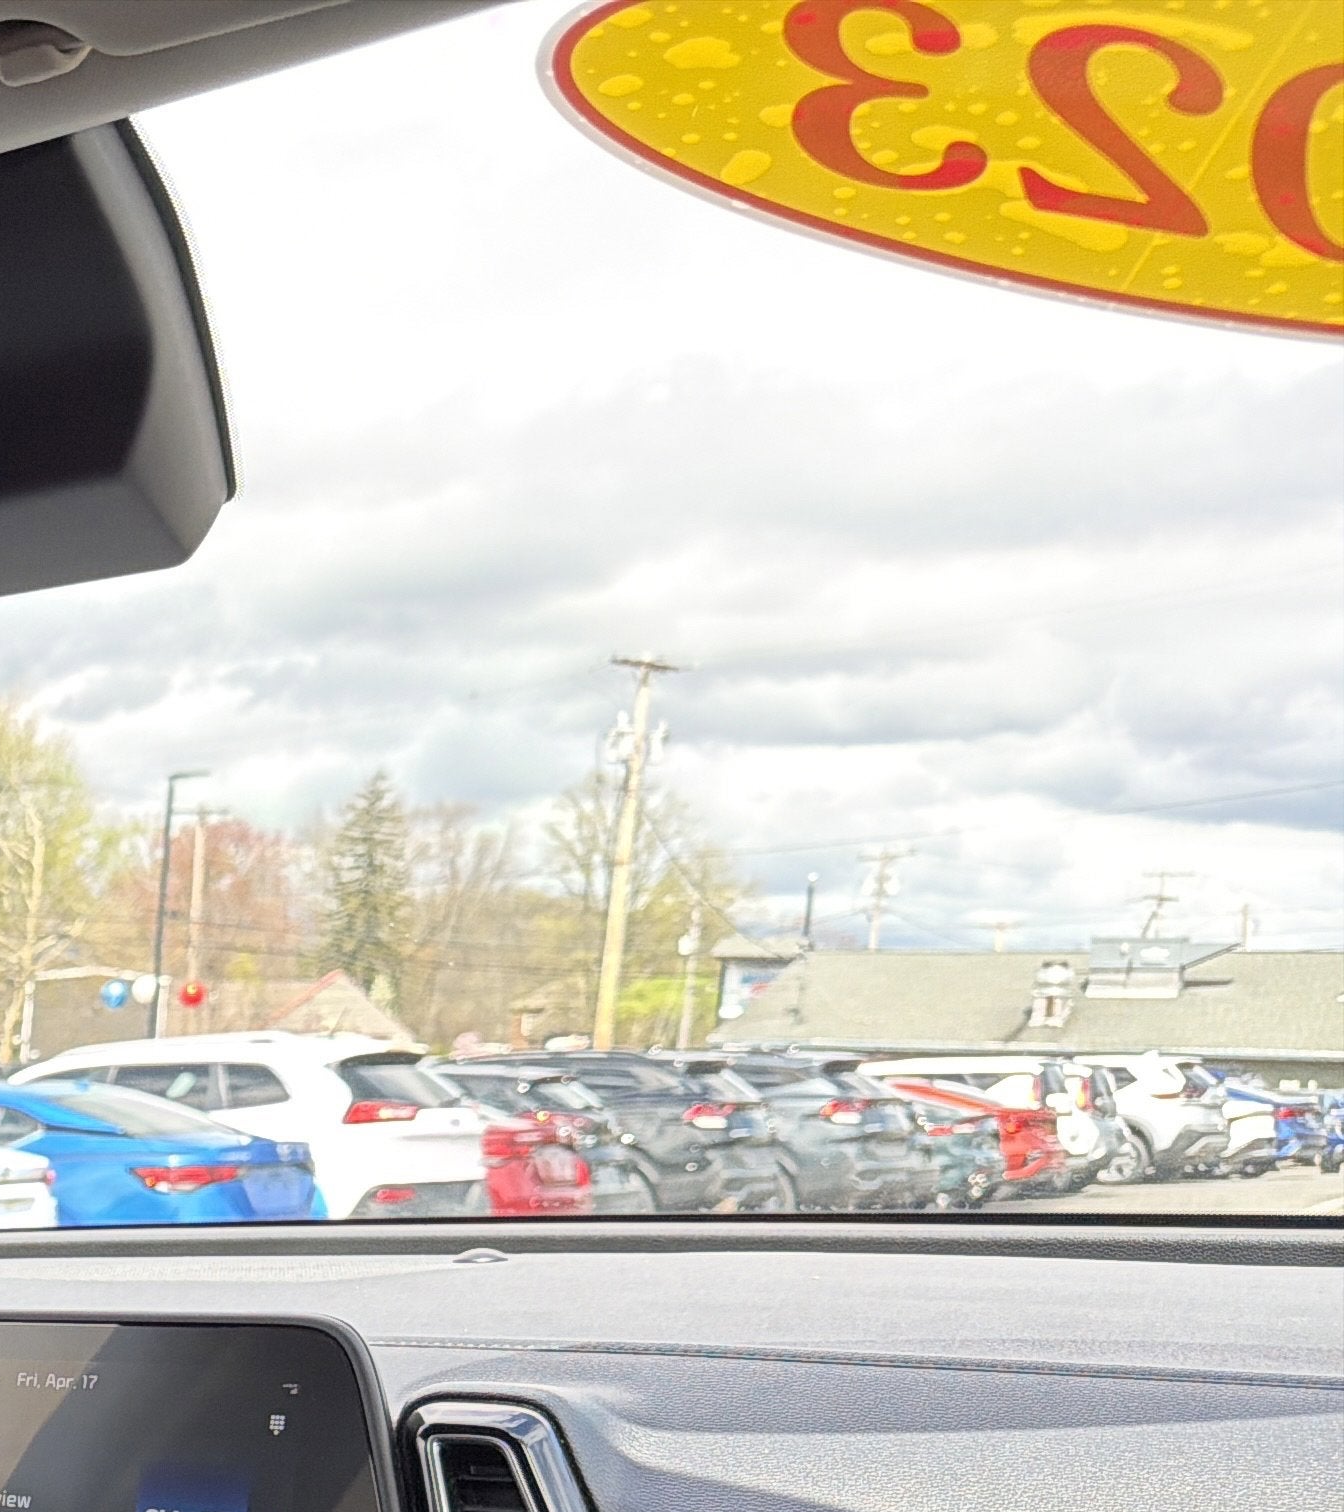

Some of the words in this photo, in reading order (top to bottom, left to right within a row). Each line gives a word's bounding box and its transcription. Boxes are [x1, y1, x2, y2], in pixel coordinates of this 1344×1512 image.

[16, 1372, 42, 1390] Fri,
[44, 1373, 78, 1392] Apr.
[82, 1374, 99, 1390] 17
